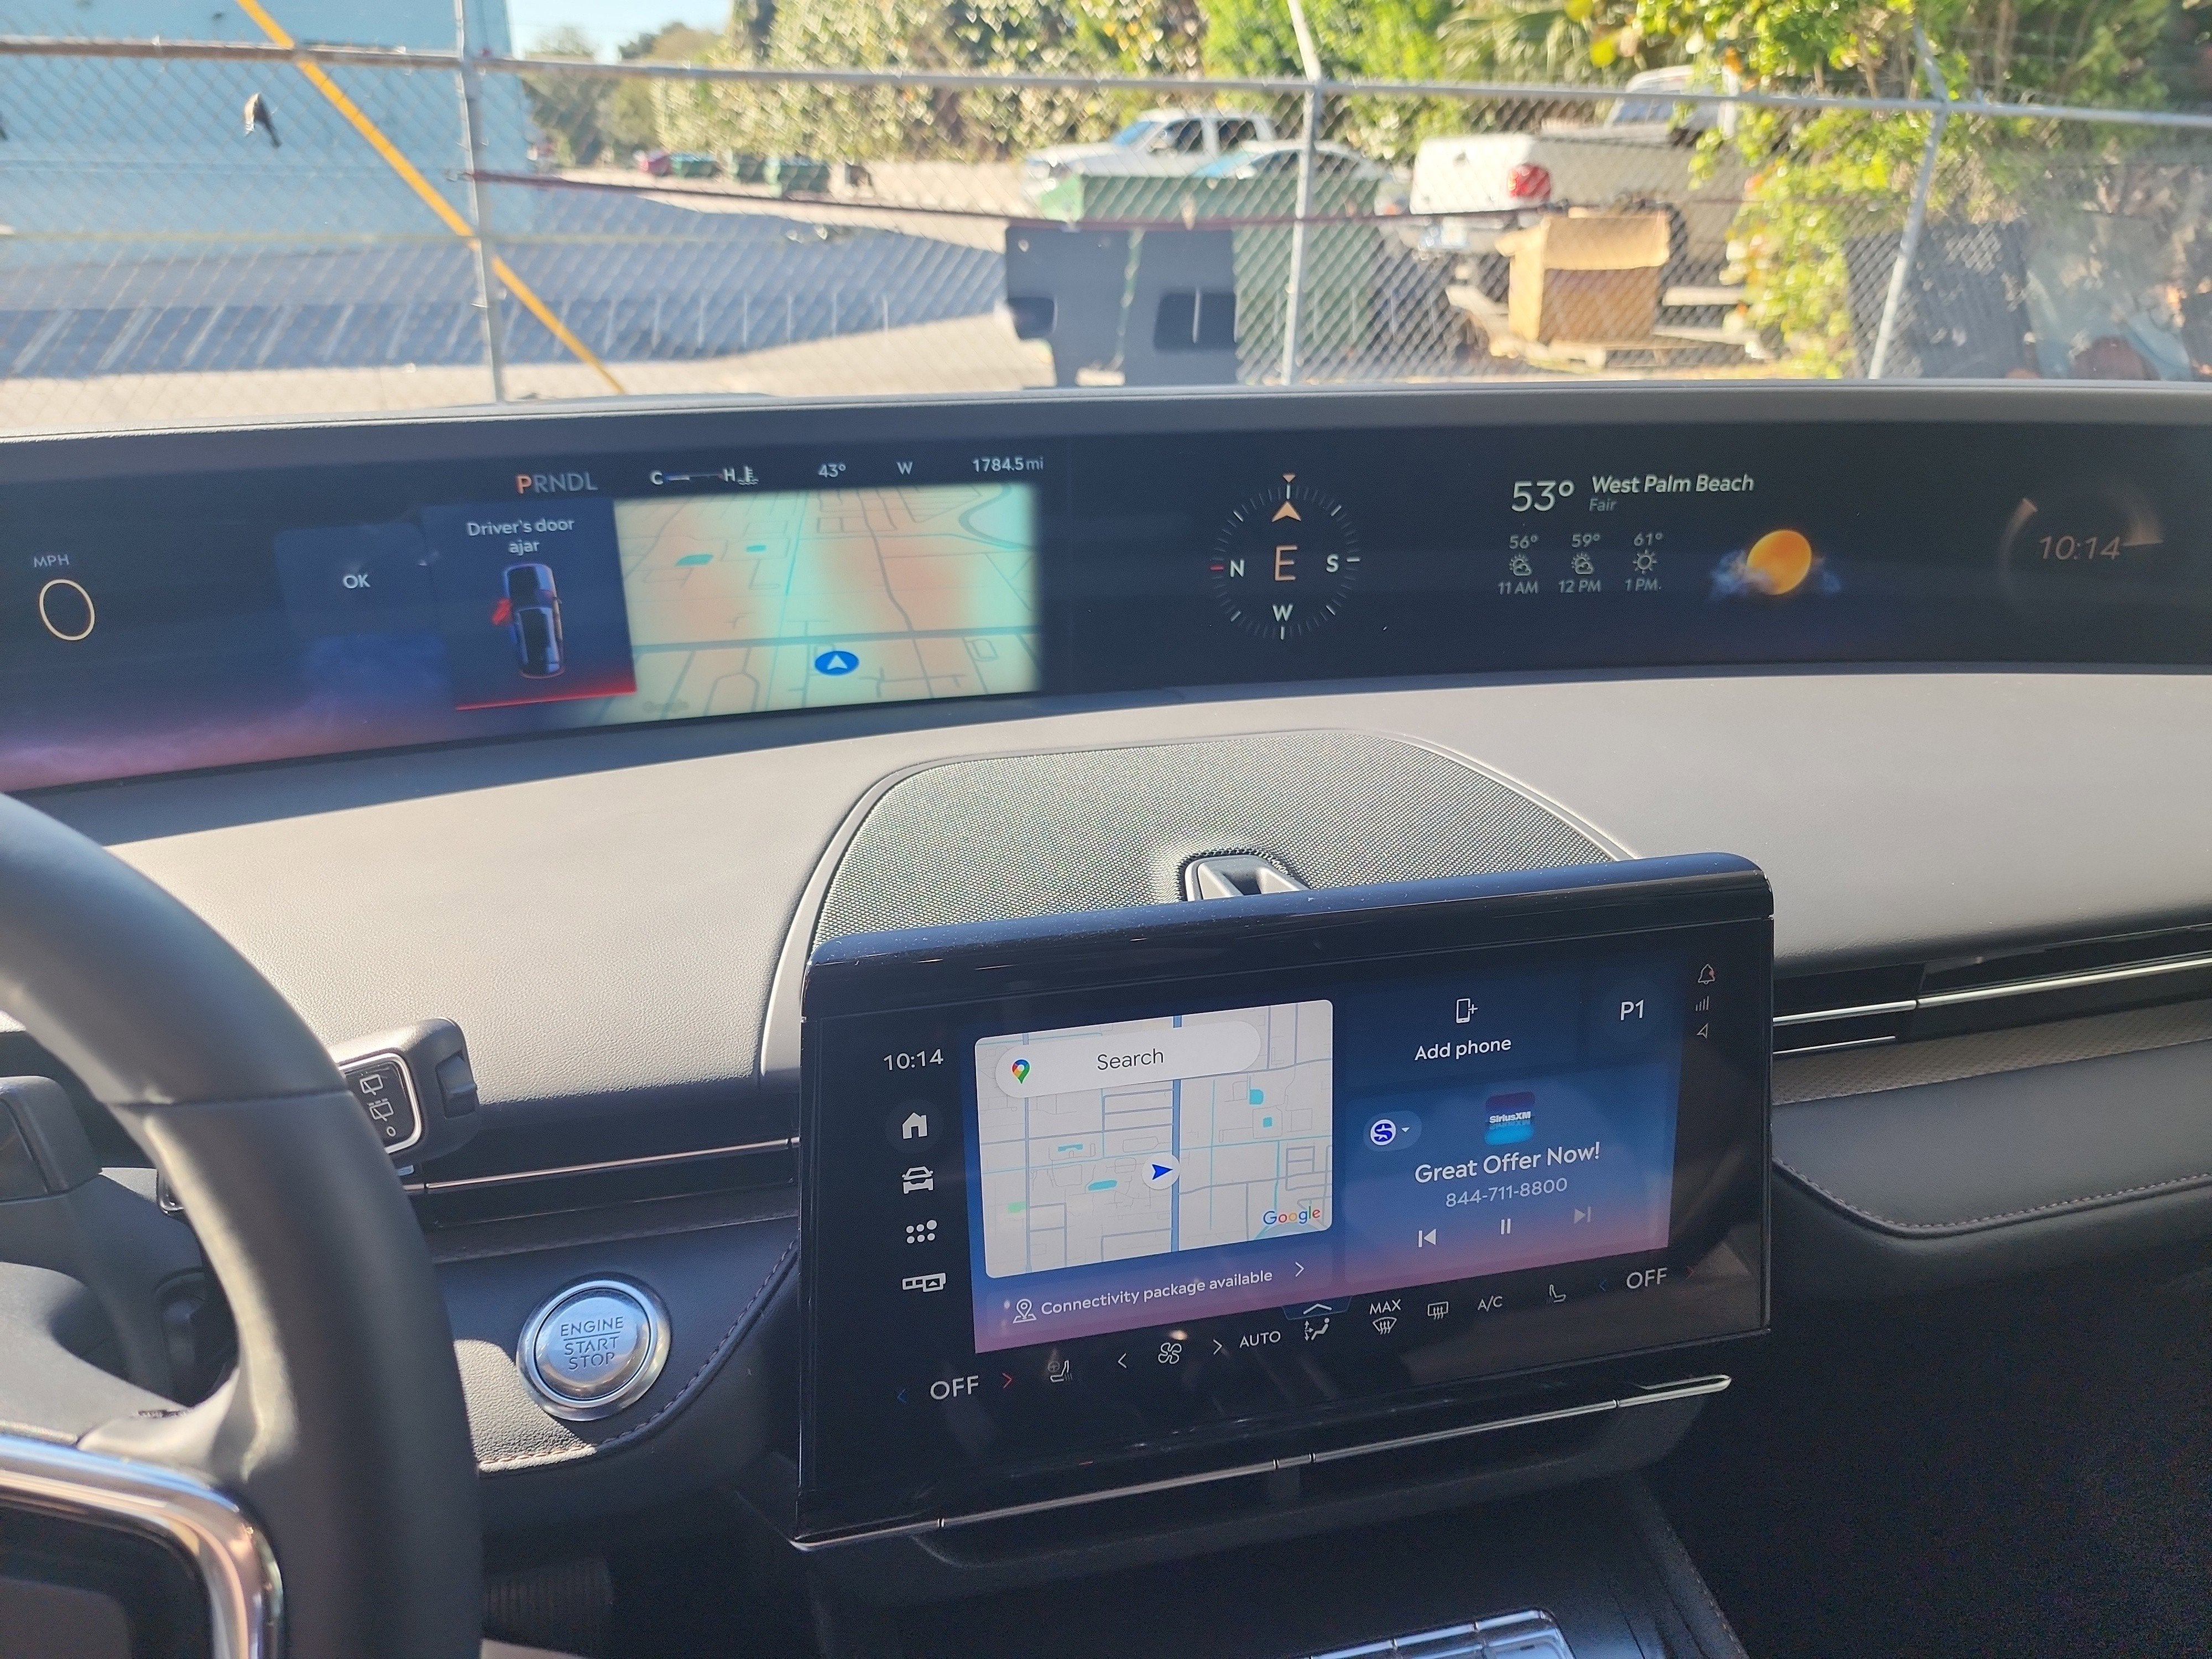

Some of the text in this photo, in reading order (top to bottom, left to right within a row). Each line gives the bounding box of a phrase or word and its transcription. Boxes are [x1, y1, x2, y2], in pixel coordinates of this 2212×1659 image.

[723, 468, 735, 482] H
[897, 462, 912, 474] W
[651, 471, 663, 485] C
[1592, 473, 1754, 494] West Palm Beach
[1511, 480, 1574, 512] 53°
[1589, 498, 1616, 512] Fair
[467, 518, 575, 537] Driver's door
[508, 539, 539, 555] ajar
[2039, 536, 2121, 560] 10:14
[33, 554, 69, 568] MPH
[1230, 559, 1244, 577] N
[1275, 545, 1297, 581] E
[1327, 555, 1339, 572] S
[342, 574, 370, 589] OK
[1498, 581, 1538, 594] 11 AM
[1558, 579, 1601, 593] 12 PM
[1625, 578, 1631, 591] 1
[1272, 604, 1293, 622] W
[1620, 999, 1645, 1021] P1
[1415, 1037, 1512, 1061] Add phone
[884, 1048, 943, 1072] 10:14
[1097, 1047, 1164, 1071] Search
[1490, 1111, 1531, 1123] SiriusXM
[1415, 1141, 1600, 1183] Great Offer Now!
[1446, 1177, 1568, 1208] 844-711-8800
[1263, 1206, 1321, 1227] Google
[1626, 1267, 1668, 1290] OFF
[1041, 1269, 1272, 1316] Connectivity package available
[1370, 1299, 1401, 1314] MAX
[1478, 1295, 1503, 1311] A/C
[560, 1316, 624, 1337] ENGINE
[564, 1336, 619, 1355] START
[1239, 1331, 1281, 1348] AUTO
[568, 1352, 614, 1370] STOP
[930, 1375, 979, 1400] OFF
